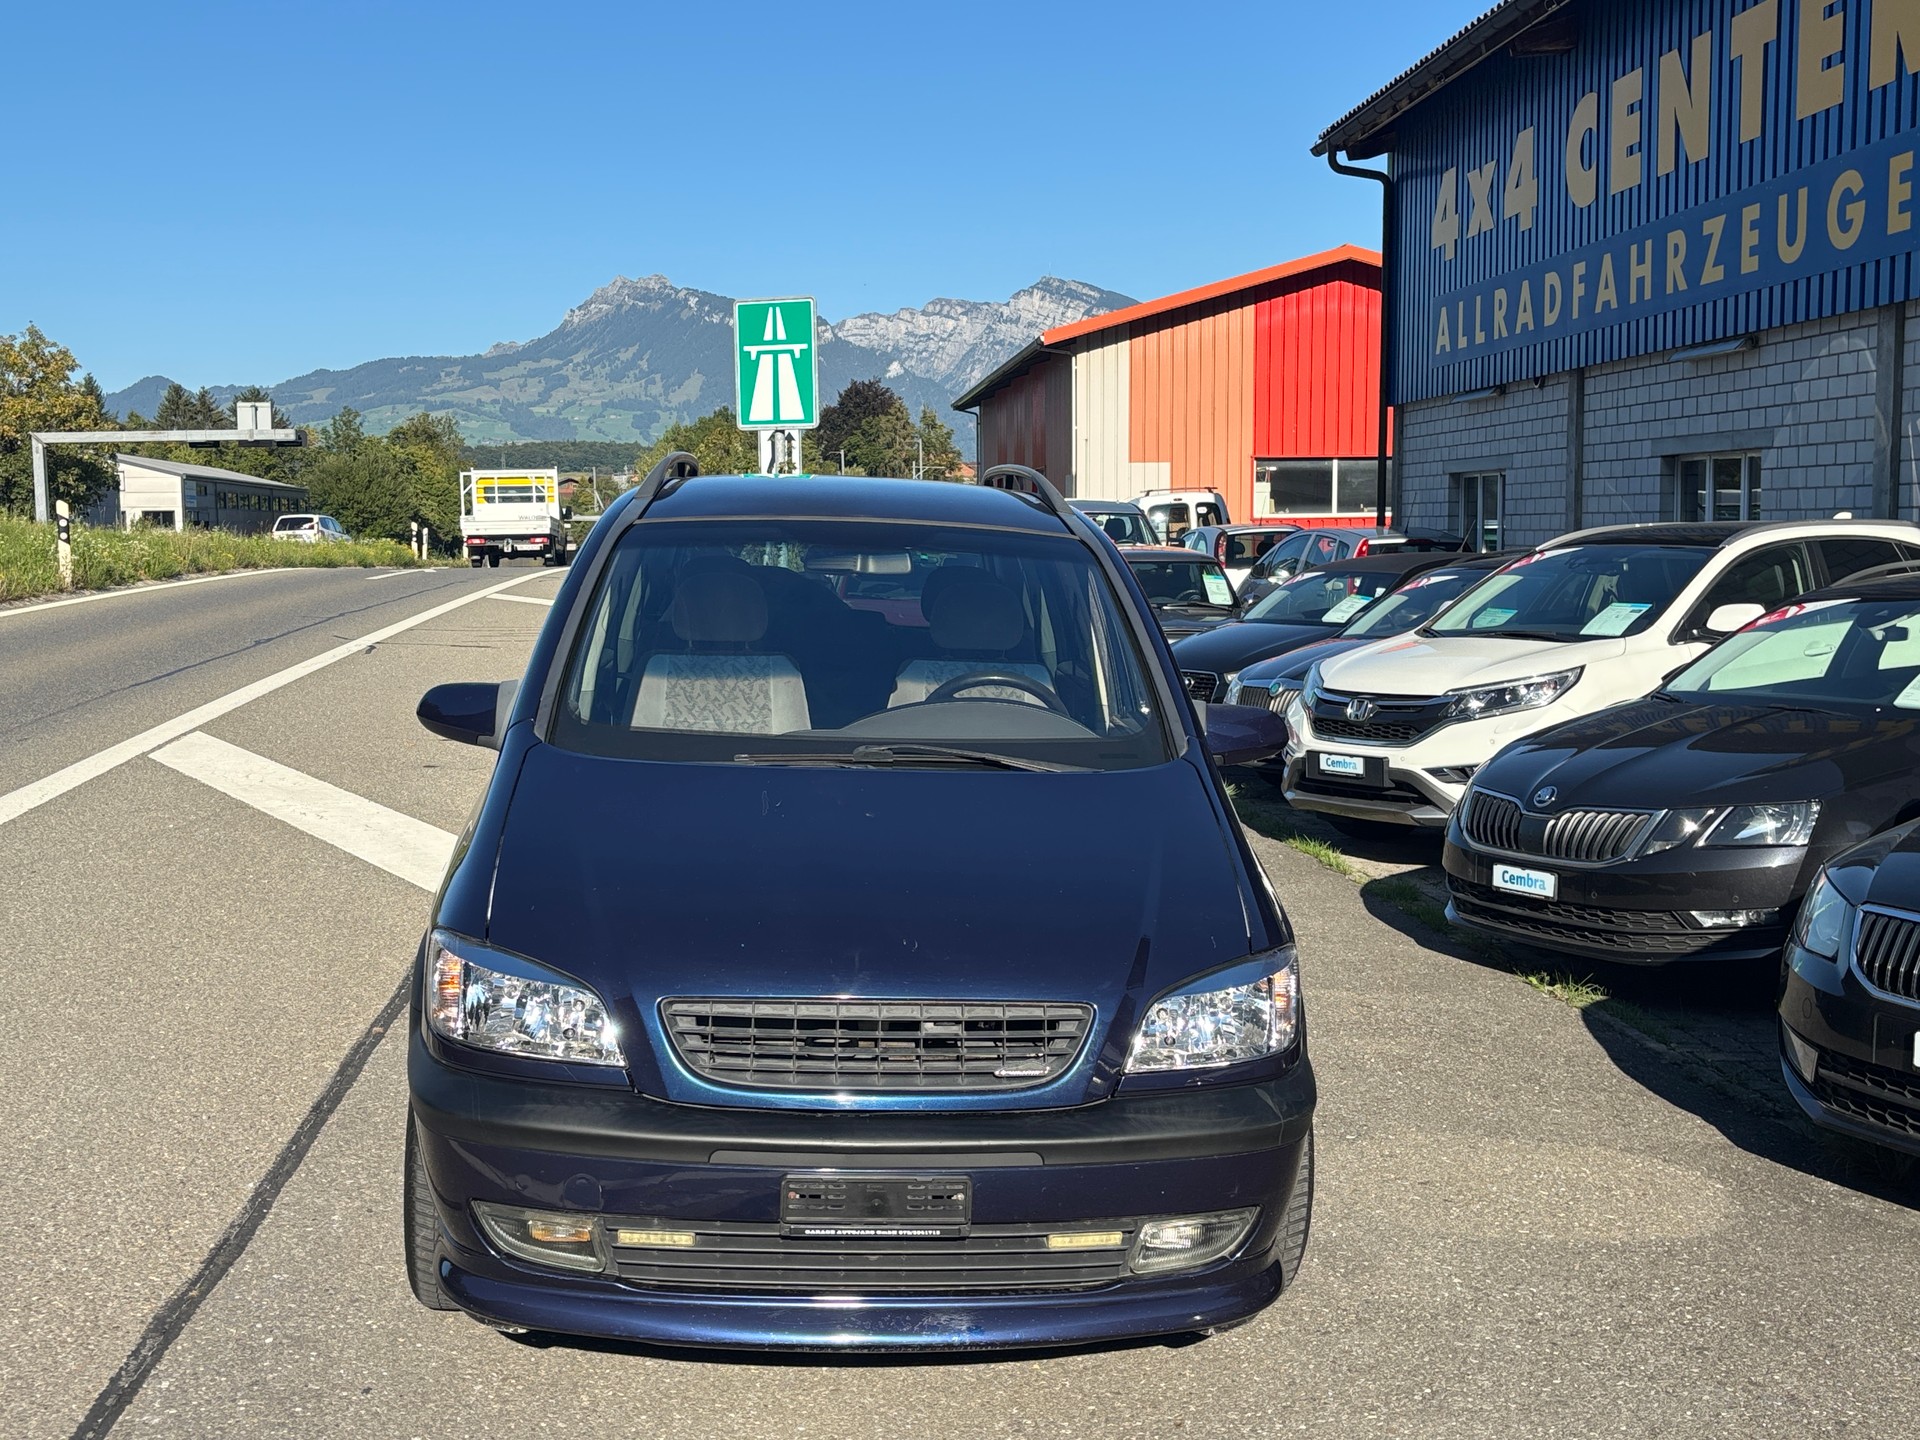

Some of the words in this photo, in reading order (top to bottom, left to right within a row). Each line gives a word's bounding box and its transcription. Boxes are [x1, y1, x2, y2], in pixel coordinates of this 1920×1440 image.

[1435, 150, 1914, 355] ALLRADFAHRZEUGE
[1325, 757, 1358, 770] Cembra
[1502, 870, 1547, 891] Cembra
